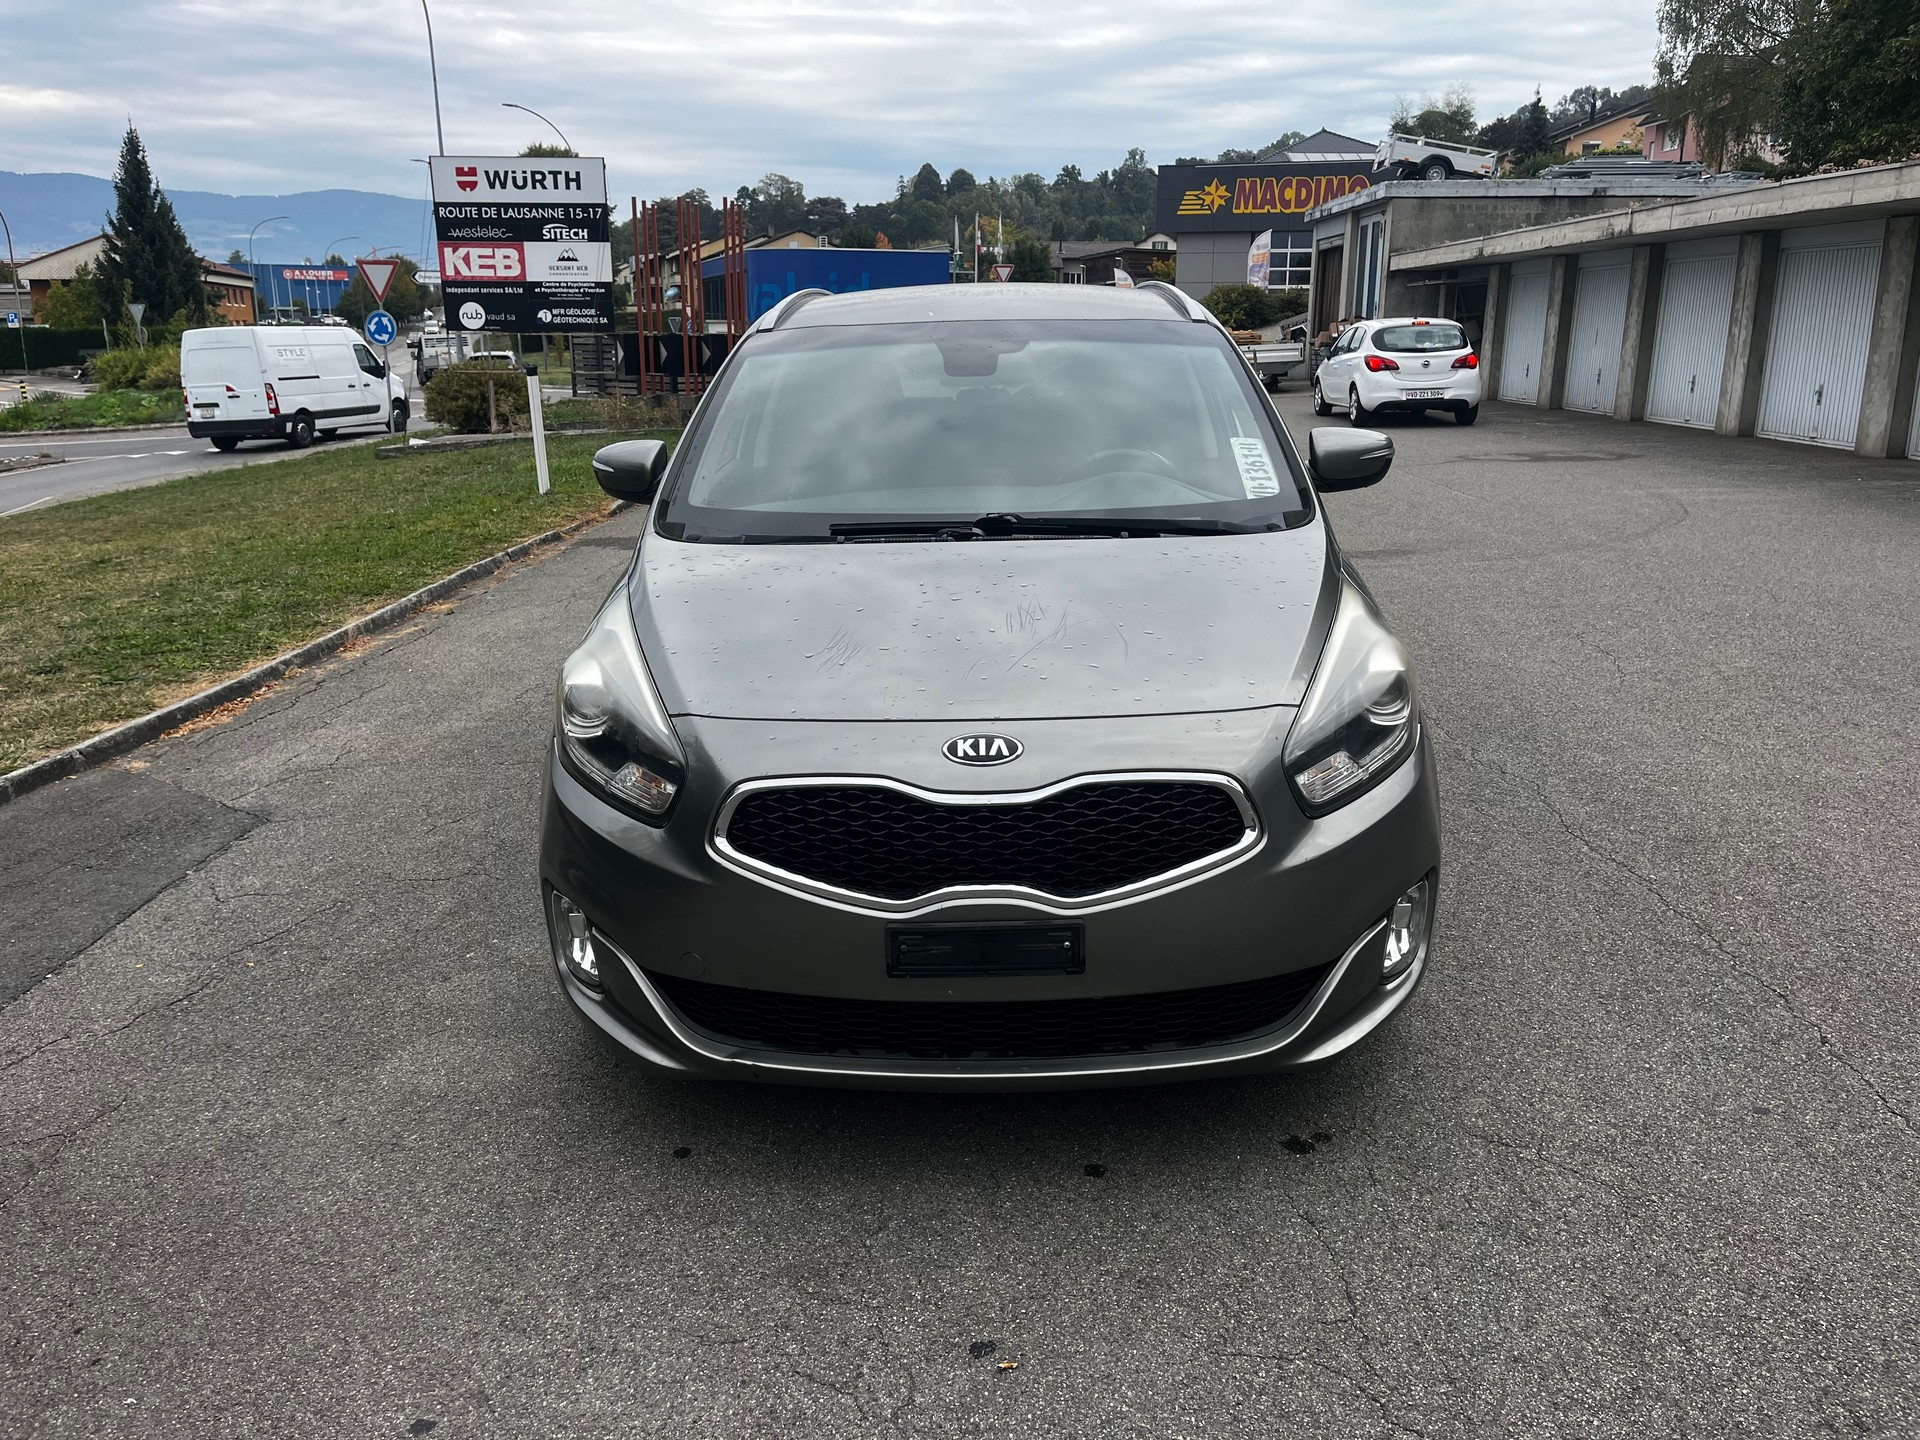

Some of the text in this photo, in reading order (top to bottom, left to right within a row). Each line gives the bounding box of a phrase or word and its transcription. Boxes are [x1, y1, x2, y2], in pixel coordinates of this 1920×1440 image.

[484, 170, 582, 190] WÜRTH
[439, 207, 602, 219] ROUTE DE LAUSANNE 15-17
[449, 225, 510, 238] westelec
[542, 228, 588, 240] SITECH
[443, 247, 522, 277] KEB
[277, 348, 306, 357] STYLE
[956, 738, 1010, 757] KIA
